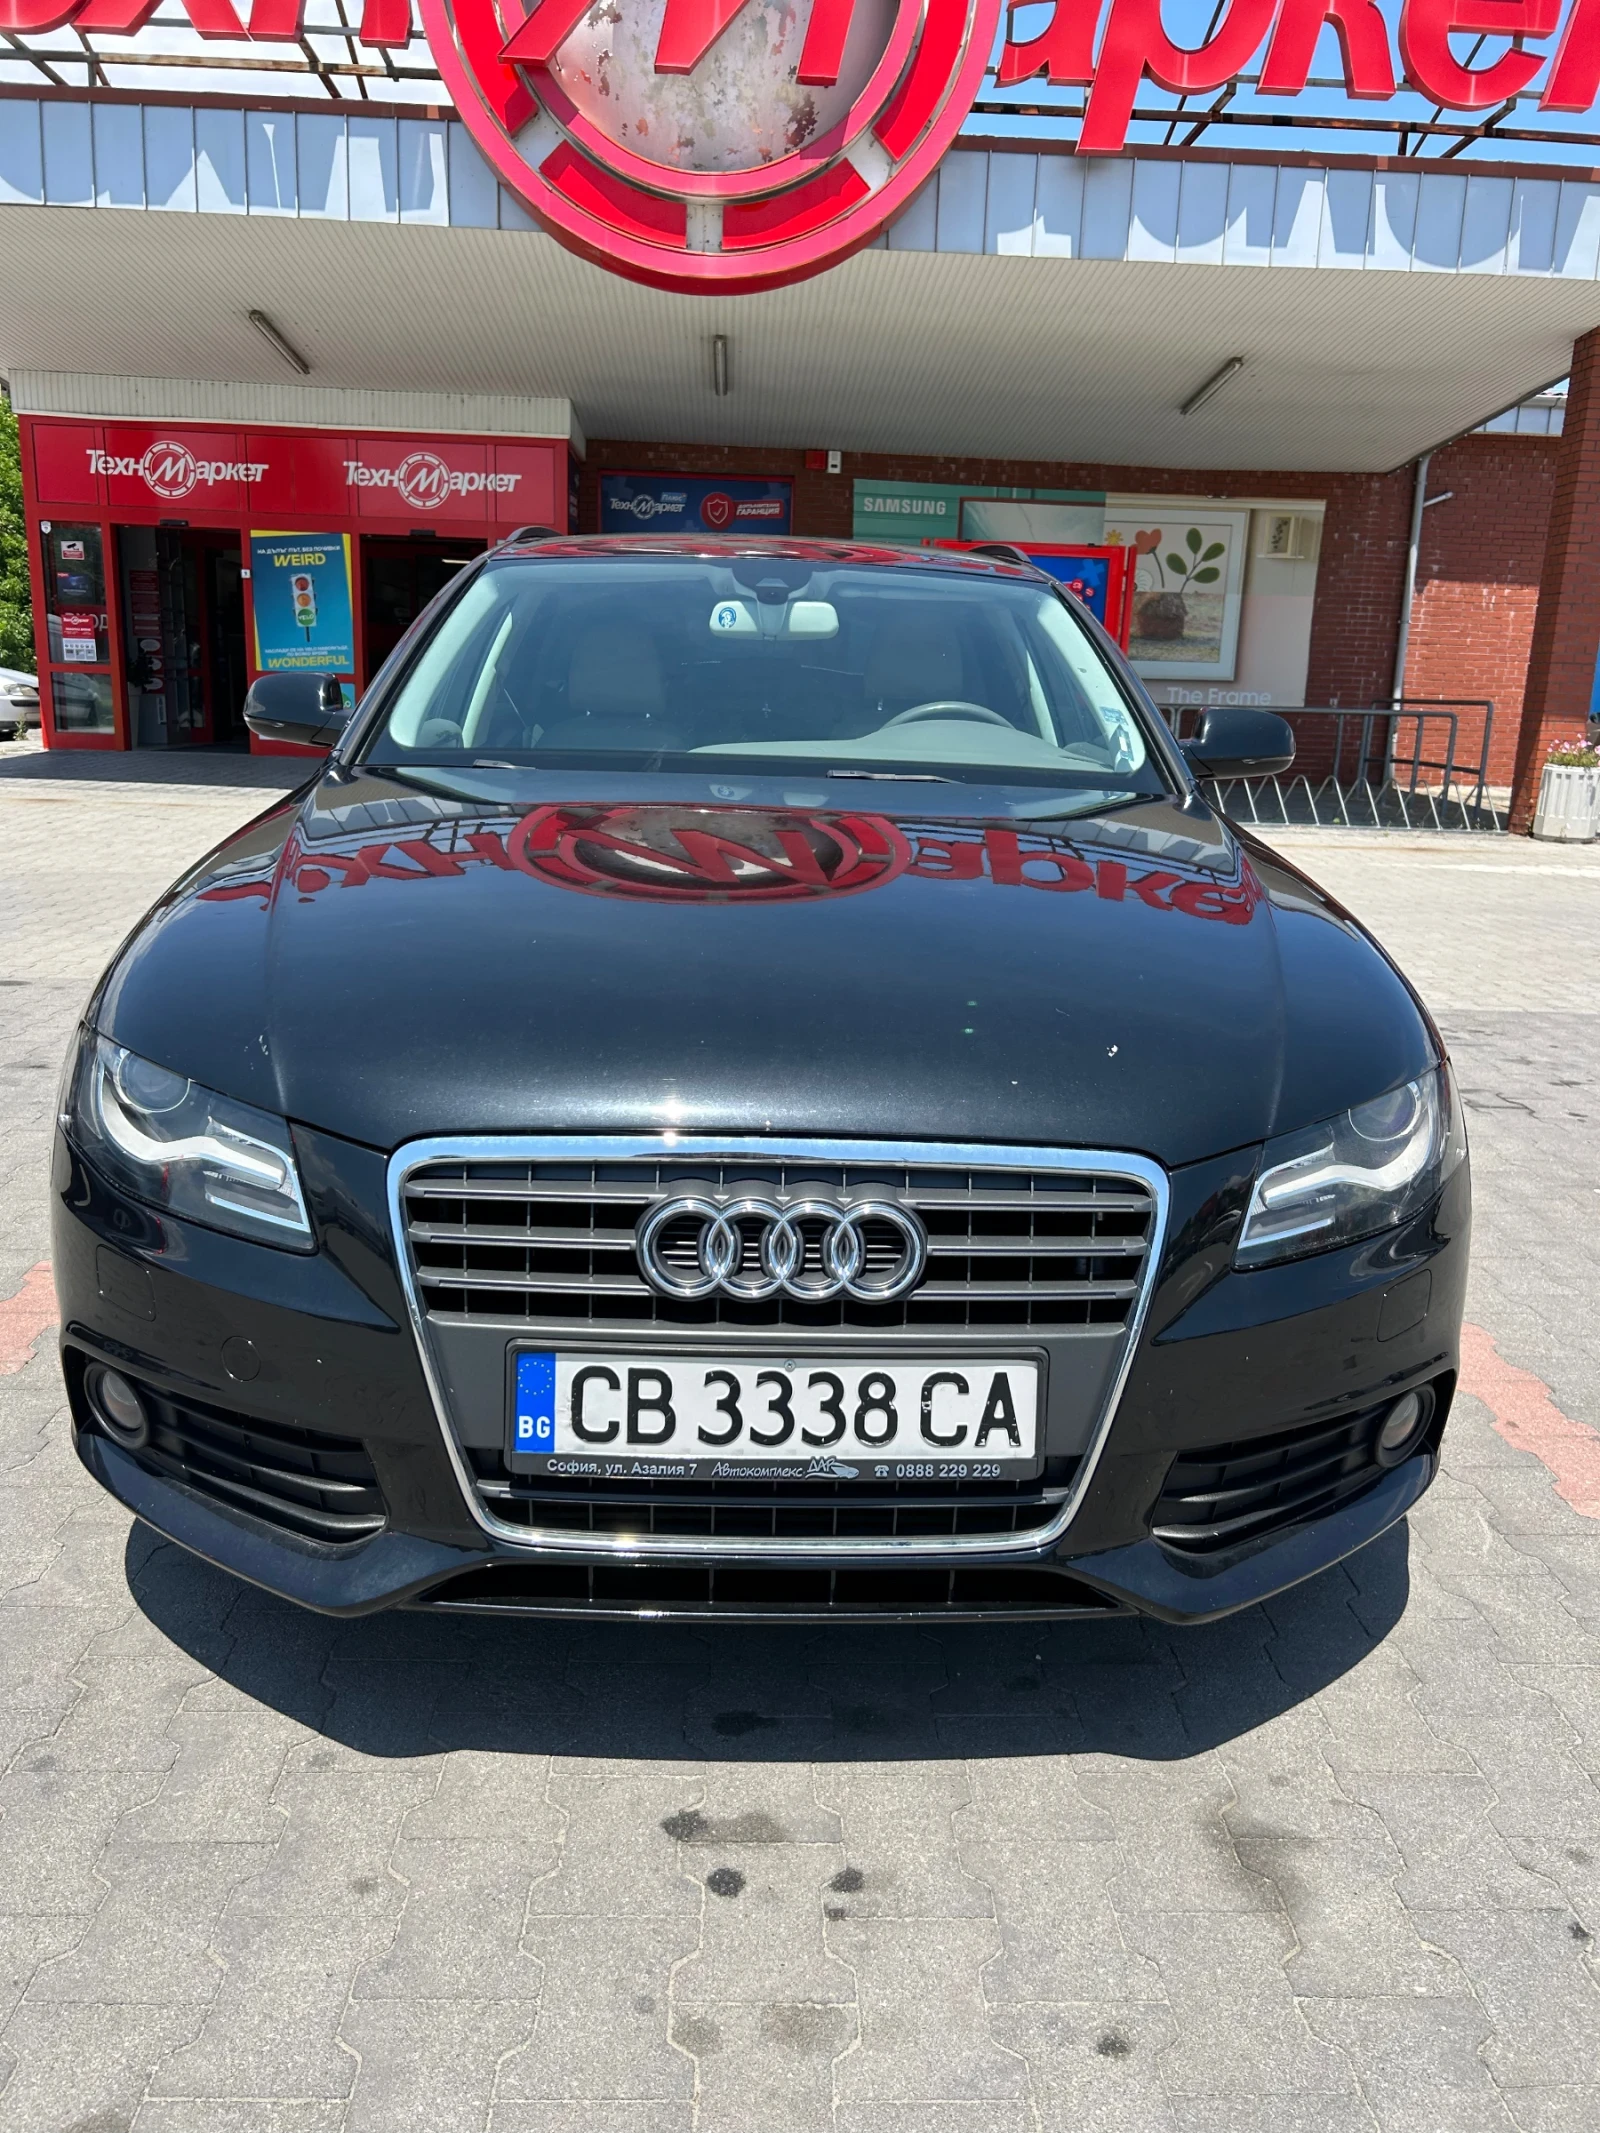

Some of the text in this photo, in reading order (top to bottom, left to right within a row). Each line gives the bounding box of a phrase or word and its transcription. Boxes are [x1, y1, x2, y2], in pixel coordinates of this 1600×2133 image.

[736, 508, 780, 516] ГАРАНЦИЯ
[863, 497, 947, 515] SAMSUNG
[273, 553, 326, 568] WEIRD
[268, 655, 350, 669] WONDERFUL
[1167, 687, 1272, 705] The Frame
[697, 1370, 898, 1447] 3338
[518, 1415, 551, 1438] BG
[547, 1458, 698, 1476] София, ул. Азалия 7
[711, 1461, 803, 1478] Автокомплекс
[896, 1464, 1001, 1479] 0888 229 229
